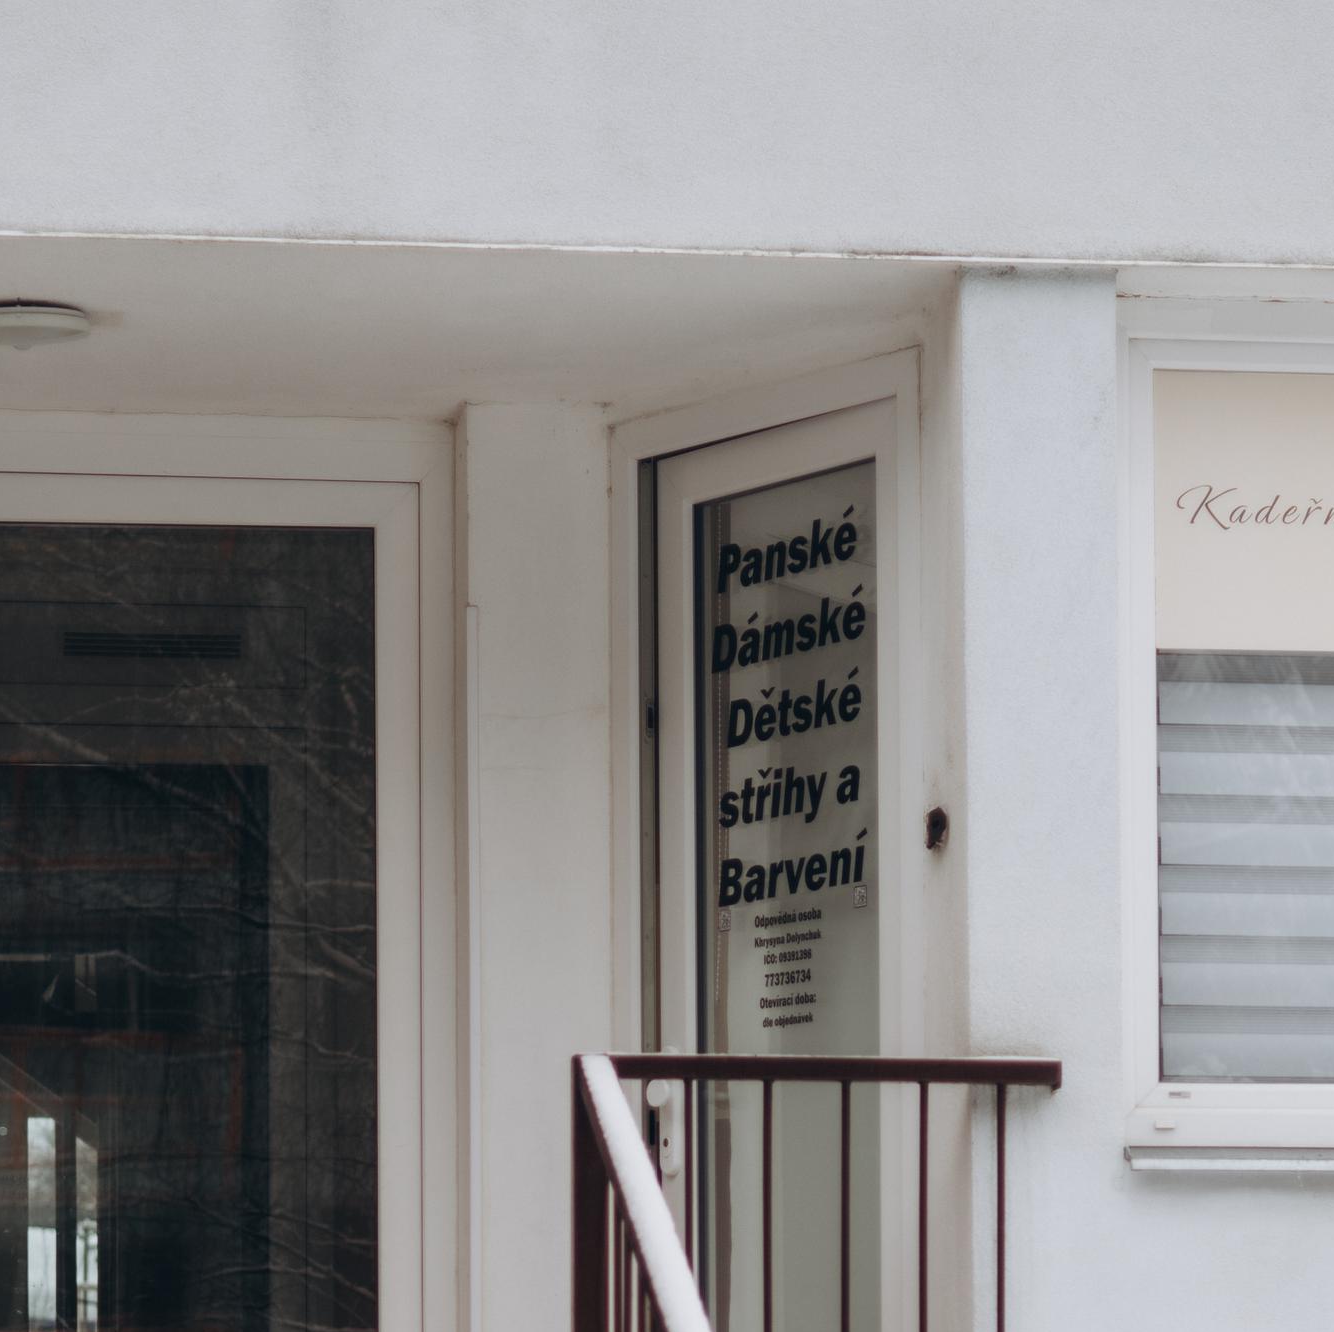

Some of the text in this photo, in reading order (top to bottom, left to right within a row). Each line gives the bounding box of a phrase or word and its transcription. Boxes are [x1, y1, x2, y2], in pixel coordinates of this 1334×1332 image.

[718, 504, 858, 594] Panské
[712, 583, 866, 674] Dámské
[727, 665, 862, 748] Dětské
[720, 765, 861, 828] střihy a
[718, 827, 868, 907] Barvení
[754, 907, 822, 930] Odpovědná osoba
[764, 968, 811, 987] 773736734
[794, 992, 816, 1006] doba:
